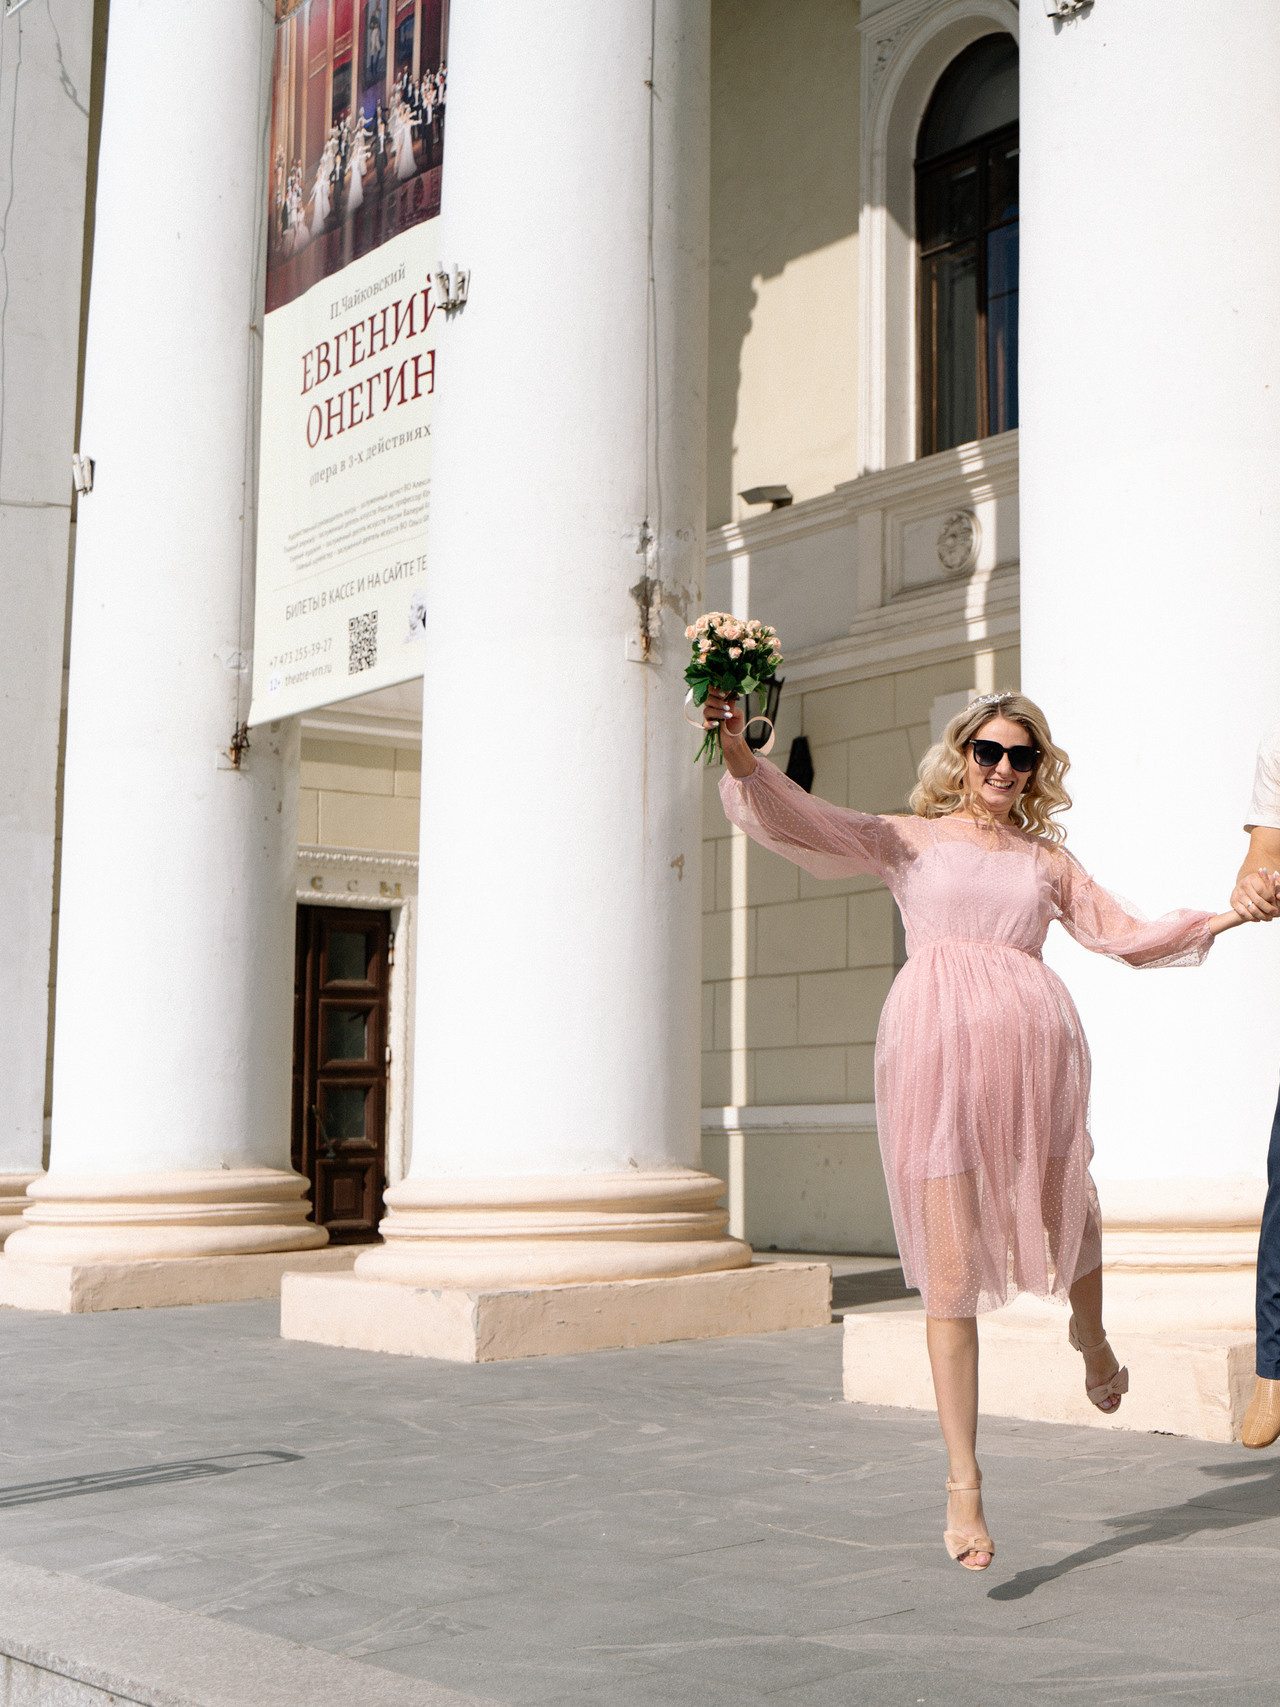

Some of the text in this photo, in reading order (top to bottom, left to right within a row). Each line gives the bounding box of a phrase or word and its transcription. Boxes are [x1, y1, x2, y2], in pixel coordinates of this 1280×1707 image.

[306, 349, 436, 449] ОНЕГИН
[309, 424, 432, 487] опера в 3-х действиях
[286, 595, 319, 620] БИЛЕТЫ
[321, 591, 327, 607] В
[329, 580, 354, 604] КАССЕ
[357, 576, 365, 593] И
[367, 572, 381, 590] НА
[383, 561, 414, 584] САЙТЕ
